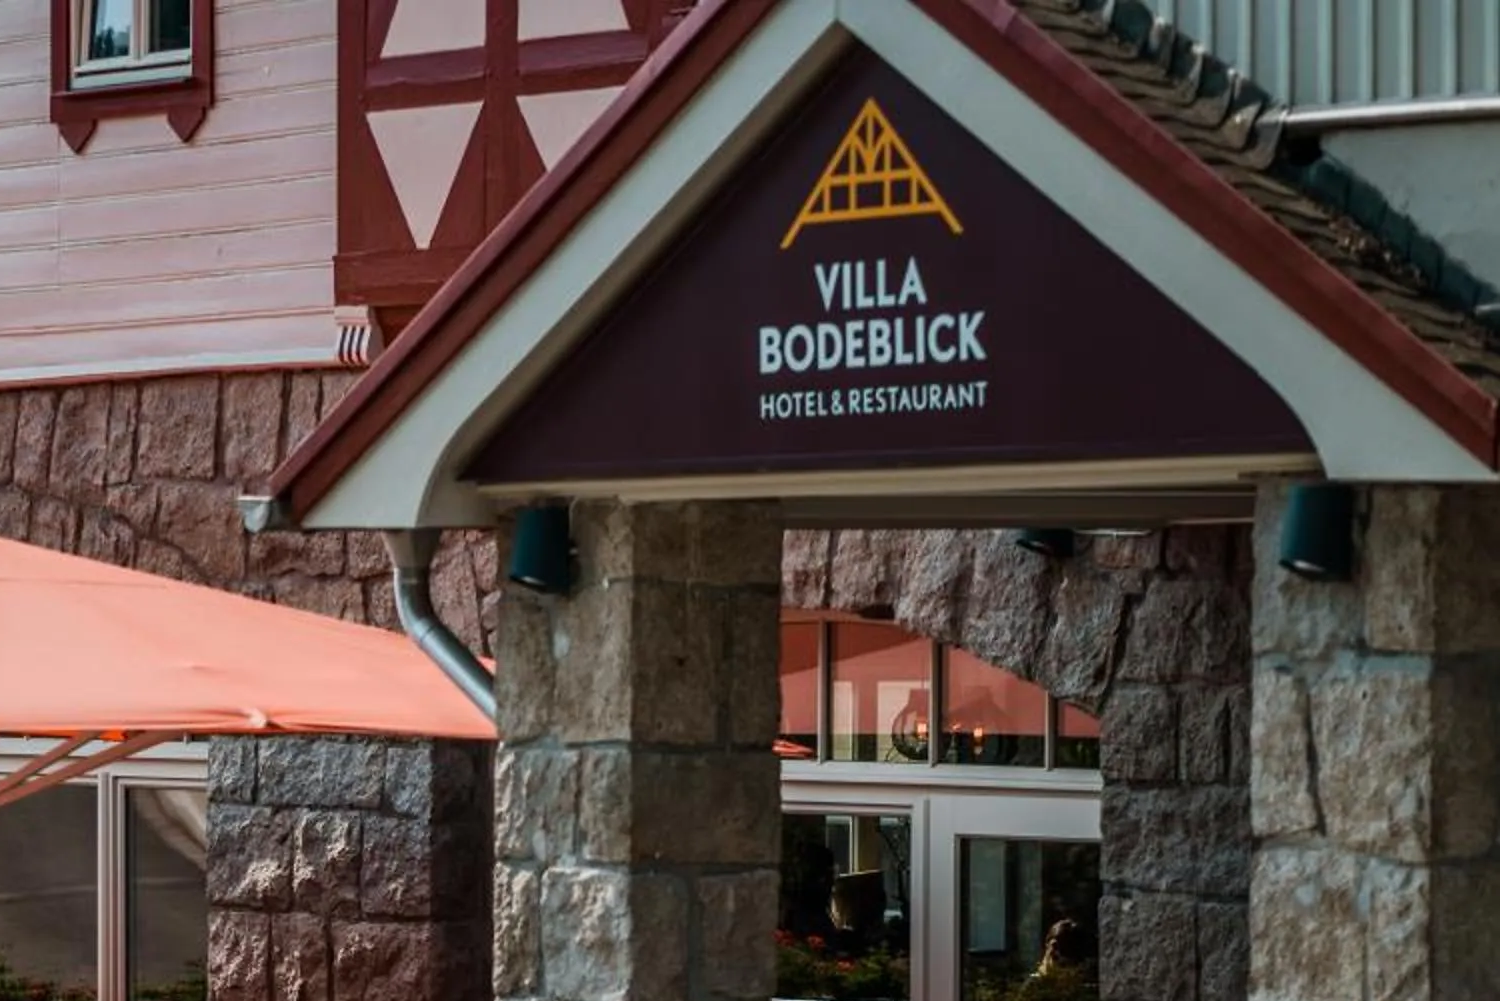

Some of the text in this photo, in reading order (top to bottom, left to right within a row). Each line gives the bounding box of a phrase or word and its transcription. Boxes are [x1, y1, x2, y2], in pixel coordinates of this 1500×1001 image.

[814, 256, 927, 311] VILLA
[759, 311, 986, 375] BODEBLICK
[760, 391, 827, 419] HOTEL
[849, 381, 988, 414] RESTAURANT
